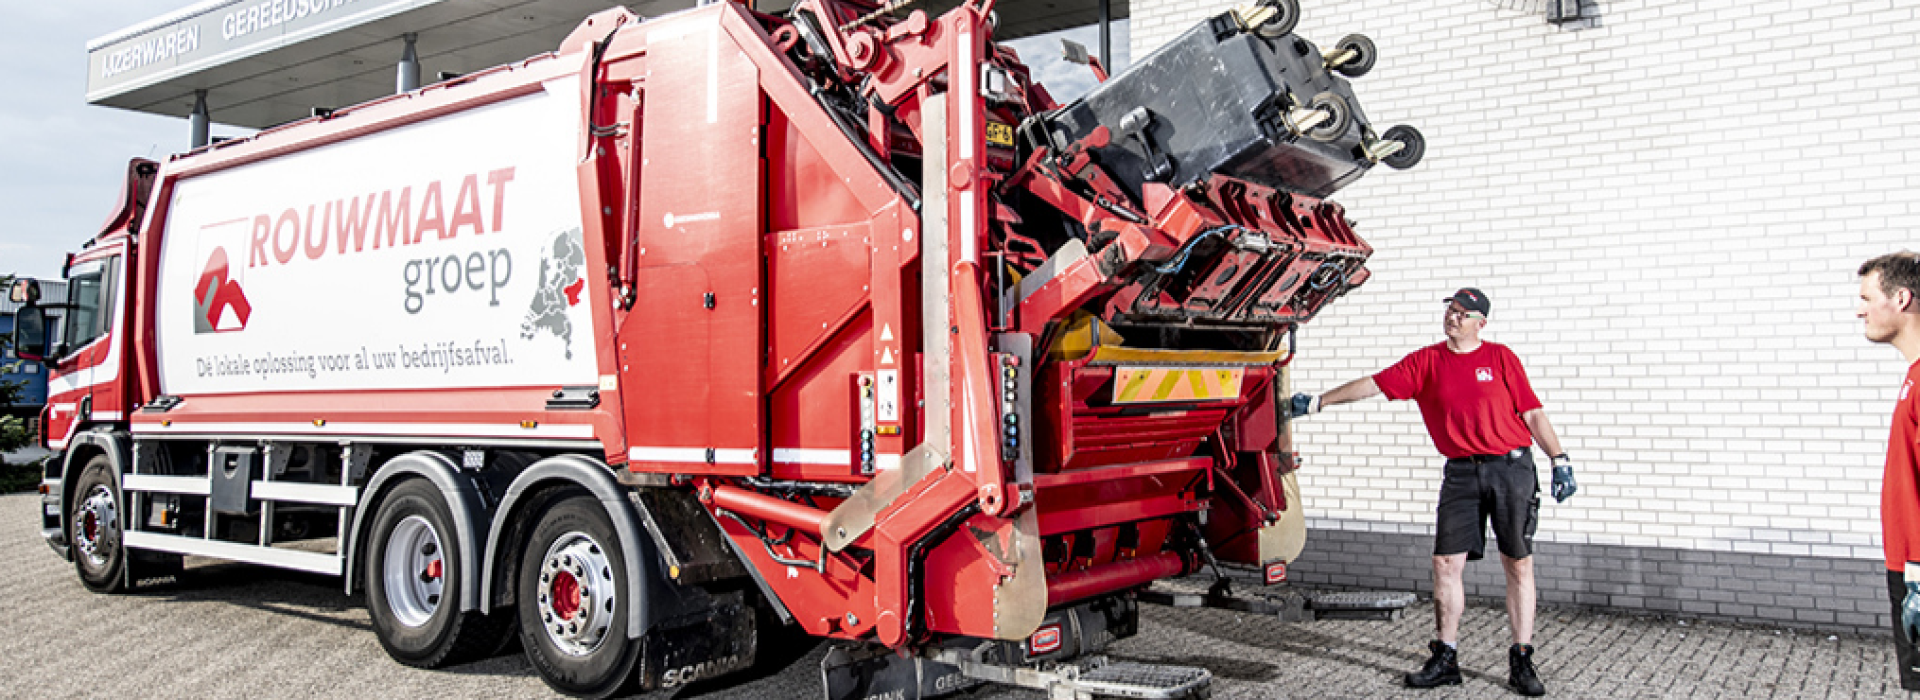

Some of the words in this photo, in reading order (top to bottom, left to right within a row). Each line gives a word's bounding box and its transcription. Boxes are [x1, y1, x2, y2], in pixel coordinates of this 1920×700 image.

[101, 25, 199, 78] IJZERWAREN
[222, 0, 347, 40] GEREEDSC
[249, 166, 516, 267] ROUWMAAT
[403, 247, 512, 314] groep
[214, 354, 250, 376] lokale
[253, 351, 316, 380] oplossing
[318, 354, 350, 371] voor
[355, 346, 369, 369] al
[372, 352, 396, 369] uw
[399, 338, 513, 374] bedrijfsafval.
